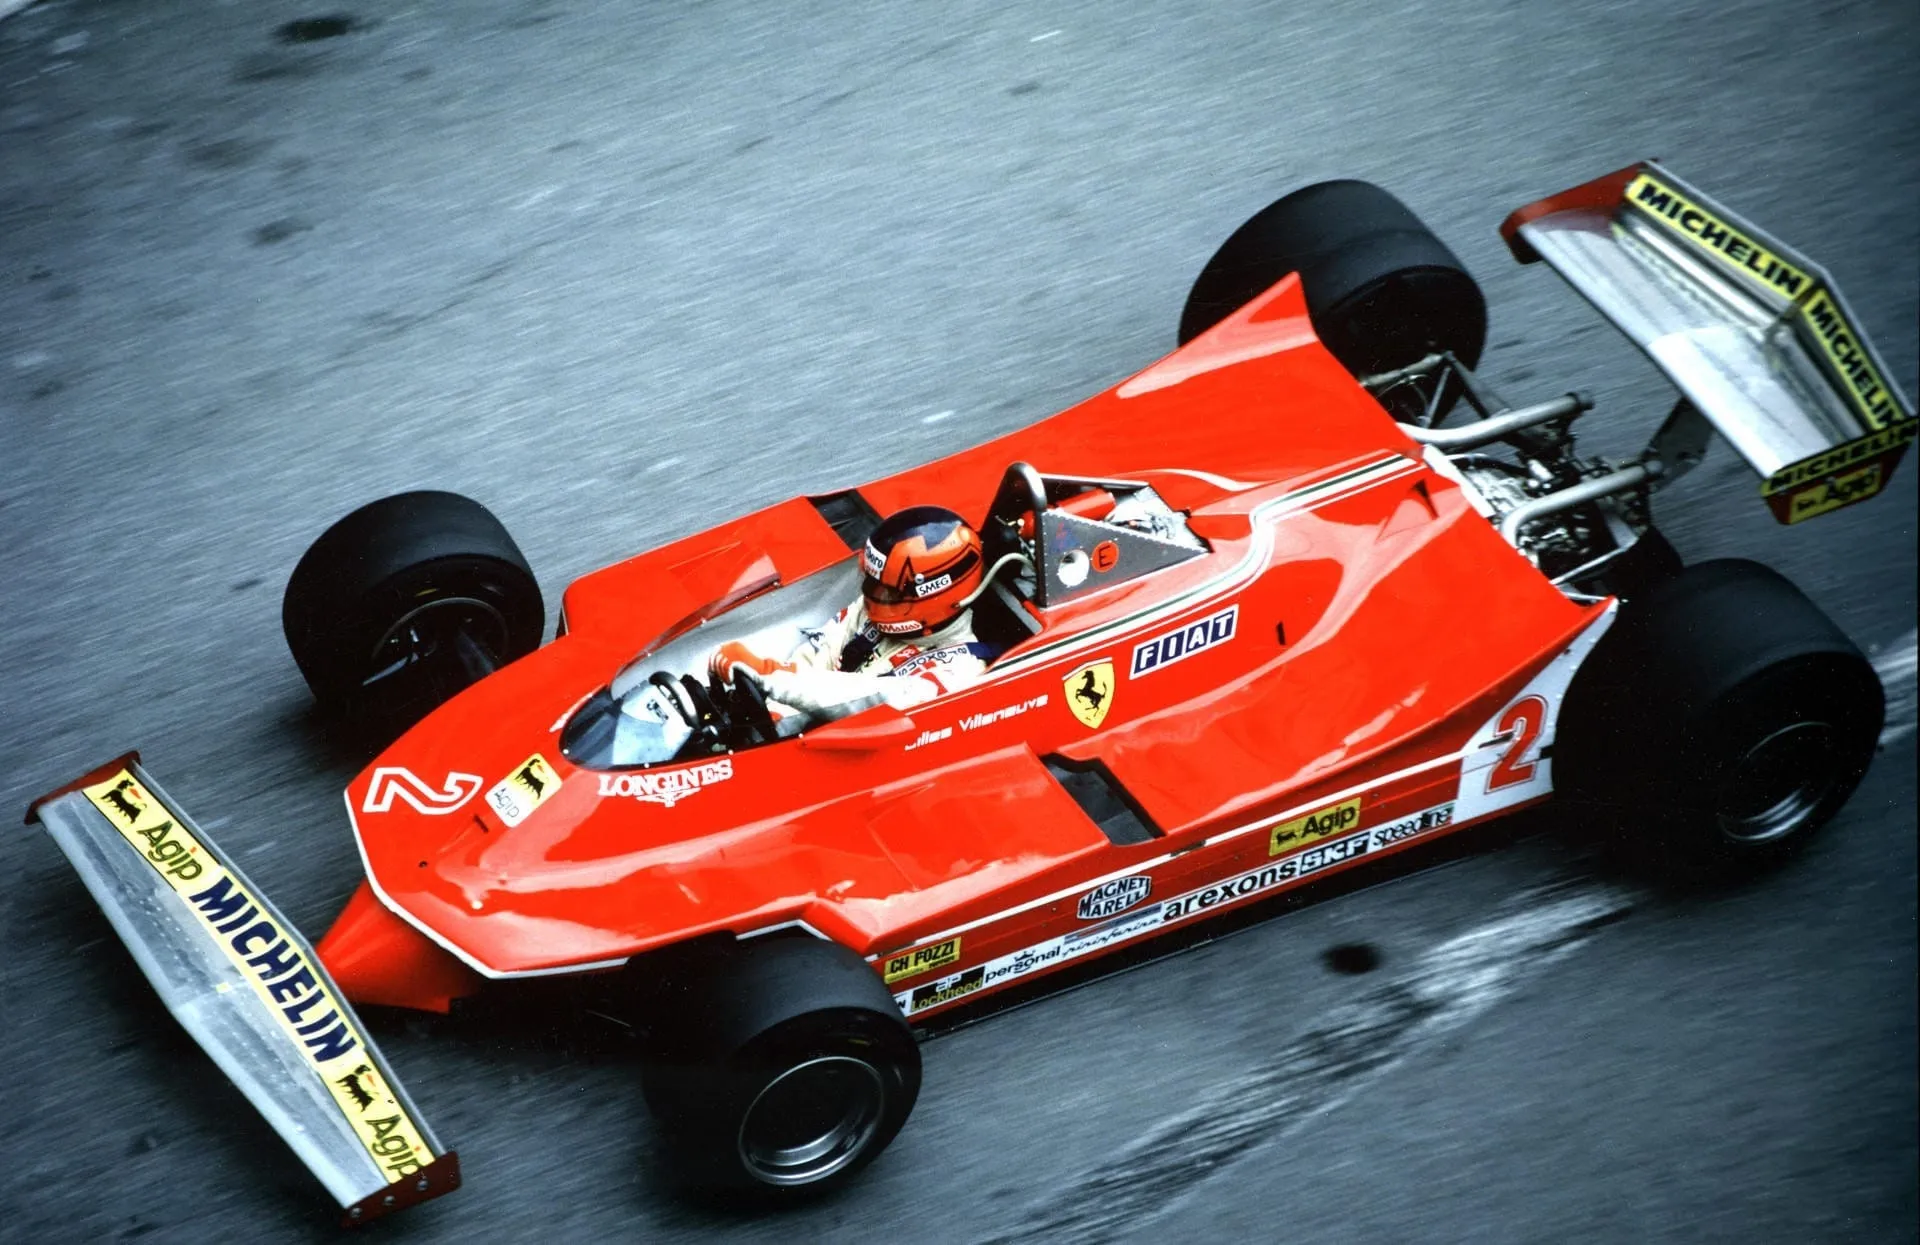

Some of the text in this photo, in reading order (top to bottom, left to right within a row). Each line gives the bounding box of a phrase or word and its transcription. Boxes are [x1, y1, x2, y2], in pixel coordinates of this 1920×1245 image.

[1637, 180, 1803, 296] MICHELIN
[1098, 544, 1112, 568] E
[918, 576, 949, 596] SMEG
[1134, 609, 1236, 675] FIAT
[958, 694, 1048, 732] Villeneuve
[1485, 693, 1549, 795] 2
[362, 767, 483, 815] 2
[598, 758, 734, 797] LONGINES
[493, 786, 520, 820] Agip
[1301, 806, 1356, 837] Agip
[137, 820, 202, 882] Agip
[1302, 834, 1370, 869] SKF
[1079, 884, 1148, 917] MARELLI
[1080, 876, 1150, 908] MAGNETI
[1163, 855, 1297, 921] arexons
[190, 876, 356, 1063] MICHELIN
[890, 957, 909, 974] CH
[914, 939, 955, 965] POZZI
[985, 946, 1060, 983] personal
[911, 975, 982, 1012] Lockheed
